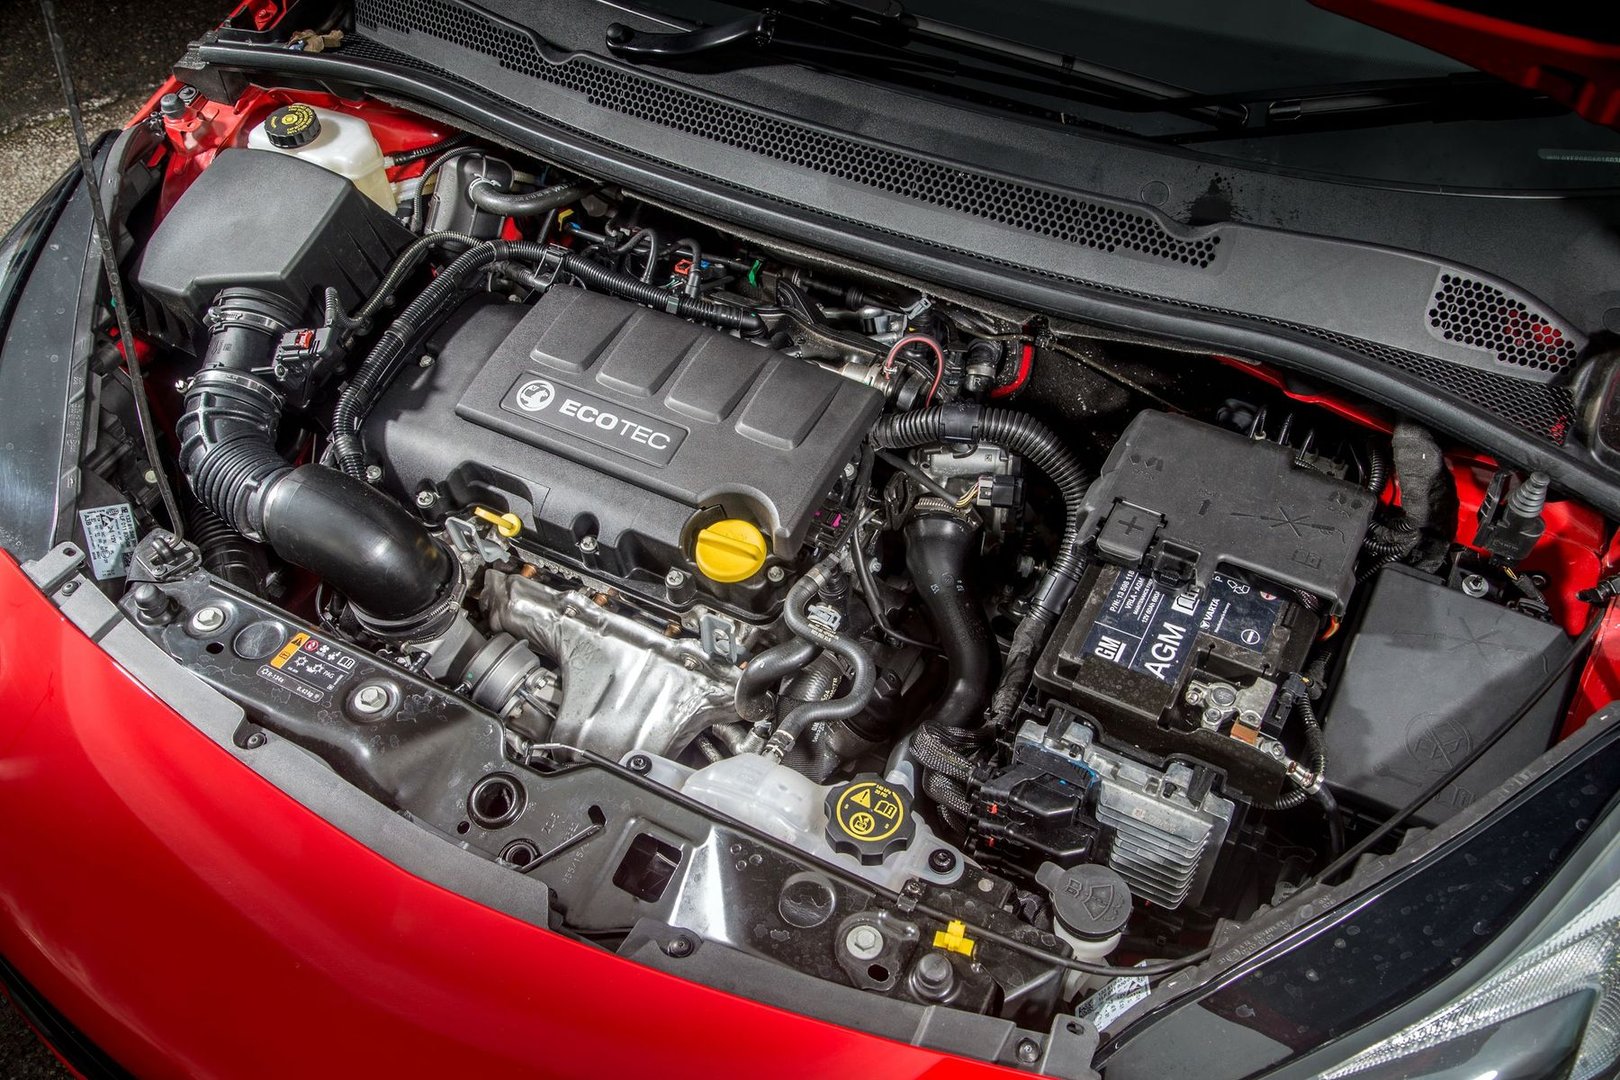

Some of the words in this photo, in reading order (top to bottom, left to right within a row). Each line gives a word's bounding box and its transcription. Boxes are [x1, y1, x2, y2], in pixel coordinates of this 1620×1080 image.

[558, 399, 670, 450] ECOTEC
[1115, 590, 1124, 599] 13
[1125, 594, 1137, 610] VRLA
[1134, 578, 1145, 591] AGM
[1204, 598, 1220, 620] VARTA
[1095, 635, 1120, 660] GM
[1144, 622, 1186, 680] AGM
